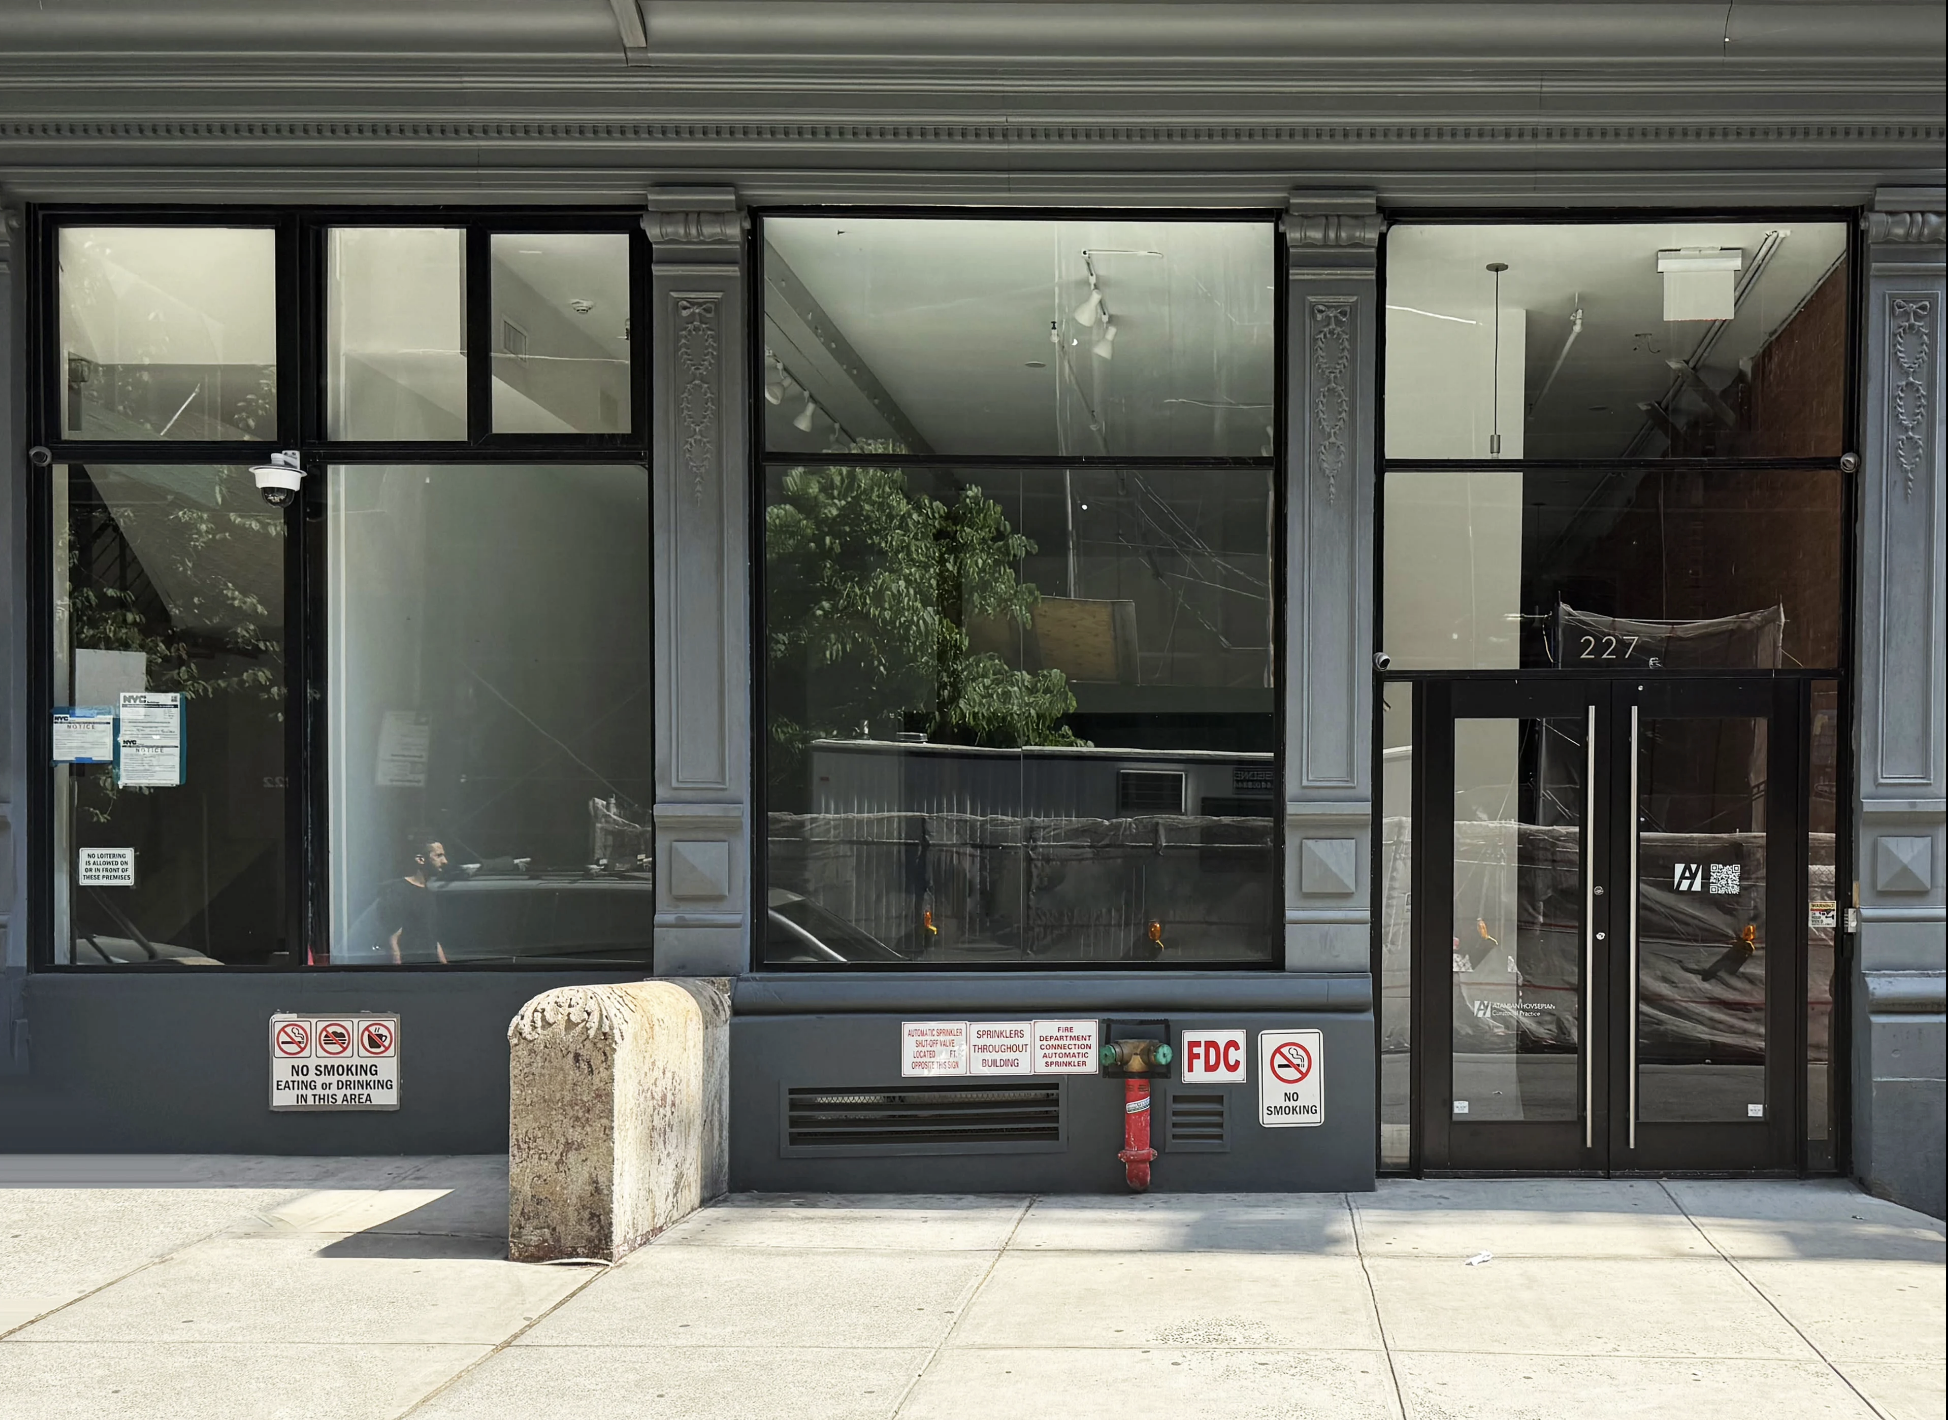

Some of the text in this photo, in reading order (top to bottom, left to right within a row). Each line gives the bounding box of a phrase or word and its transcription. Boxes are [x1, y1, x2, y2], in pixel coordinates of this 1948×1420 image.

[1580, 636, 1639, 658] 227
[123, 695, 147, 703] NYC
[908, 1028, 962, 1037] AUTOMATIC SPRINKLER
[976, 1029, 1024, 1039] SPRINKLERS
[915, 1039, 955, 1047] SHUT-OFF VALVE
[972, 1044, 1028, 1053] THROUGHOUT
[913, 1050, 936, 1058] LOCATED
[1187, 1039, 1240, 1072] FDC
[911, 1061, 959, 1069] OPPOSITE THIS SIGN
[981, 1058, 1019, 1068] BUILDING
[291, 1064, 378, 1076] NO SMOKING
[276, 1079, 393, 1090] EATING or DRINKING
[296, 1093, 372, 1104] IN THIS AREA
[1284, 1091, 1299, 1102] NO
[1266, 1104, 1318, 1115] SMOKING
